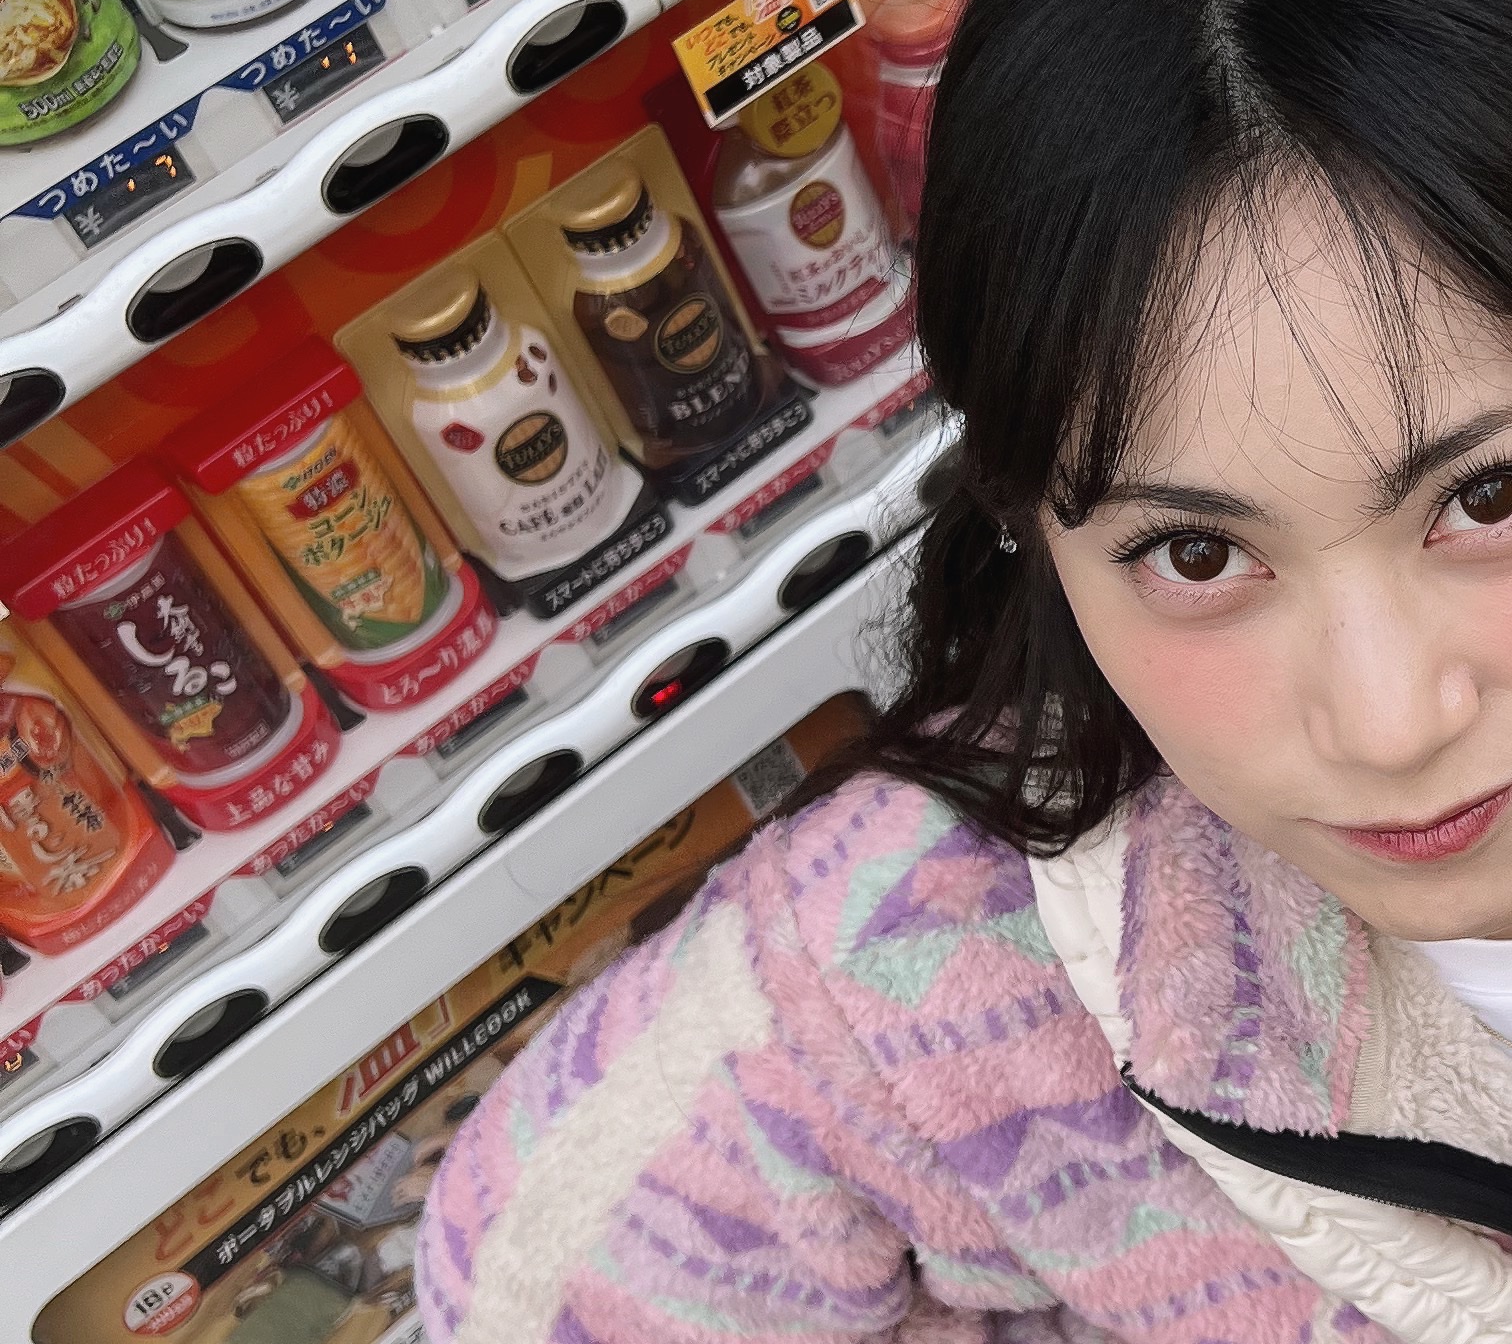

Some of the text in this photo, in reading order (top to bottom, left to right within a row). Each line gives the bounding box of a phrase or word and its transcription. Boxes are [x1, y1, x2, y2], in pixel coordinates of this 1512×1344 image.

[741, 26, 824, 90] 対象製品
[308, 485, 367, 539] コーン
[117, 621, 238, 697] しるこ
[225, 741, 330, 827] 上品な甘み
[217, 1076, 420, 1264] ポータブルレンジバッグ
[424, 987, 532, 1086] WILLCOOK
